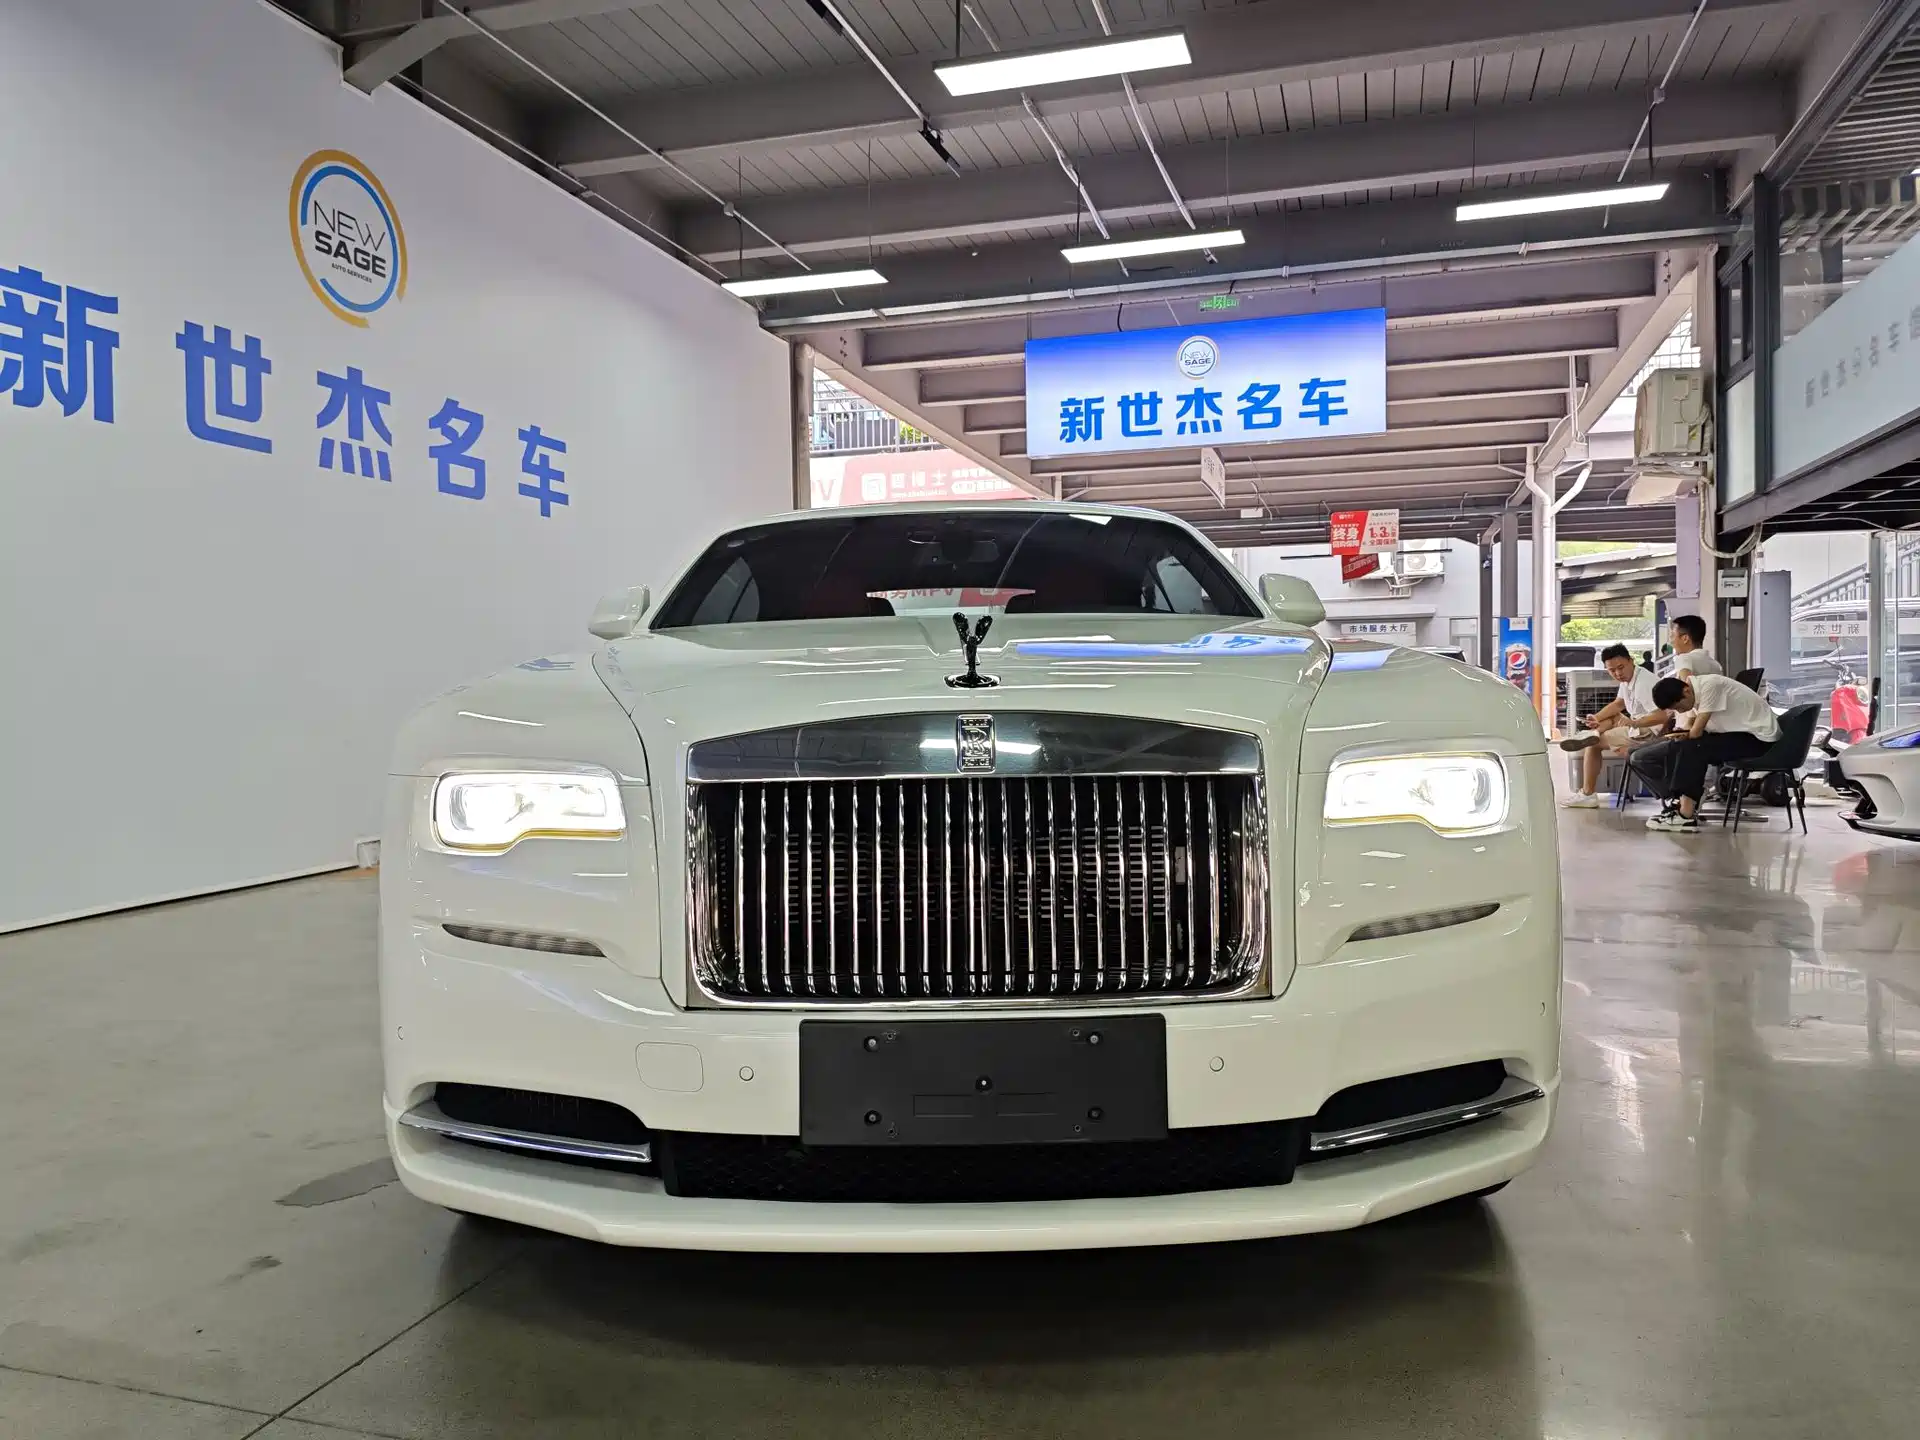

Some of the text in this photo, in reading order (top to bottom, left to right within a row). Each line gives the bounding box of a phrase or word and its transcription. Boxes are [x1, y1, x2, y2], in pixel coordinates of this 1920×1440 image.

[314, 199, 386, 252] NEW
[315, 230, 386, 279] SAGE
[331, 262, 373, 283] AUTO SERVICES
[1184, 349, 1212, 360] NEW
[1184, 358, 1212, 366] SAGE
[0, 265, 569, 518] 新世杰名车
[1059, 377, 1348, 443] 新世杰名车
[1349, 623, 1409, 634] 市场服务大厅
